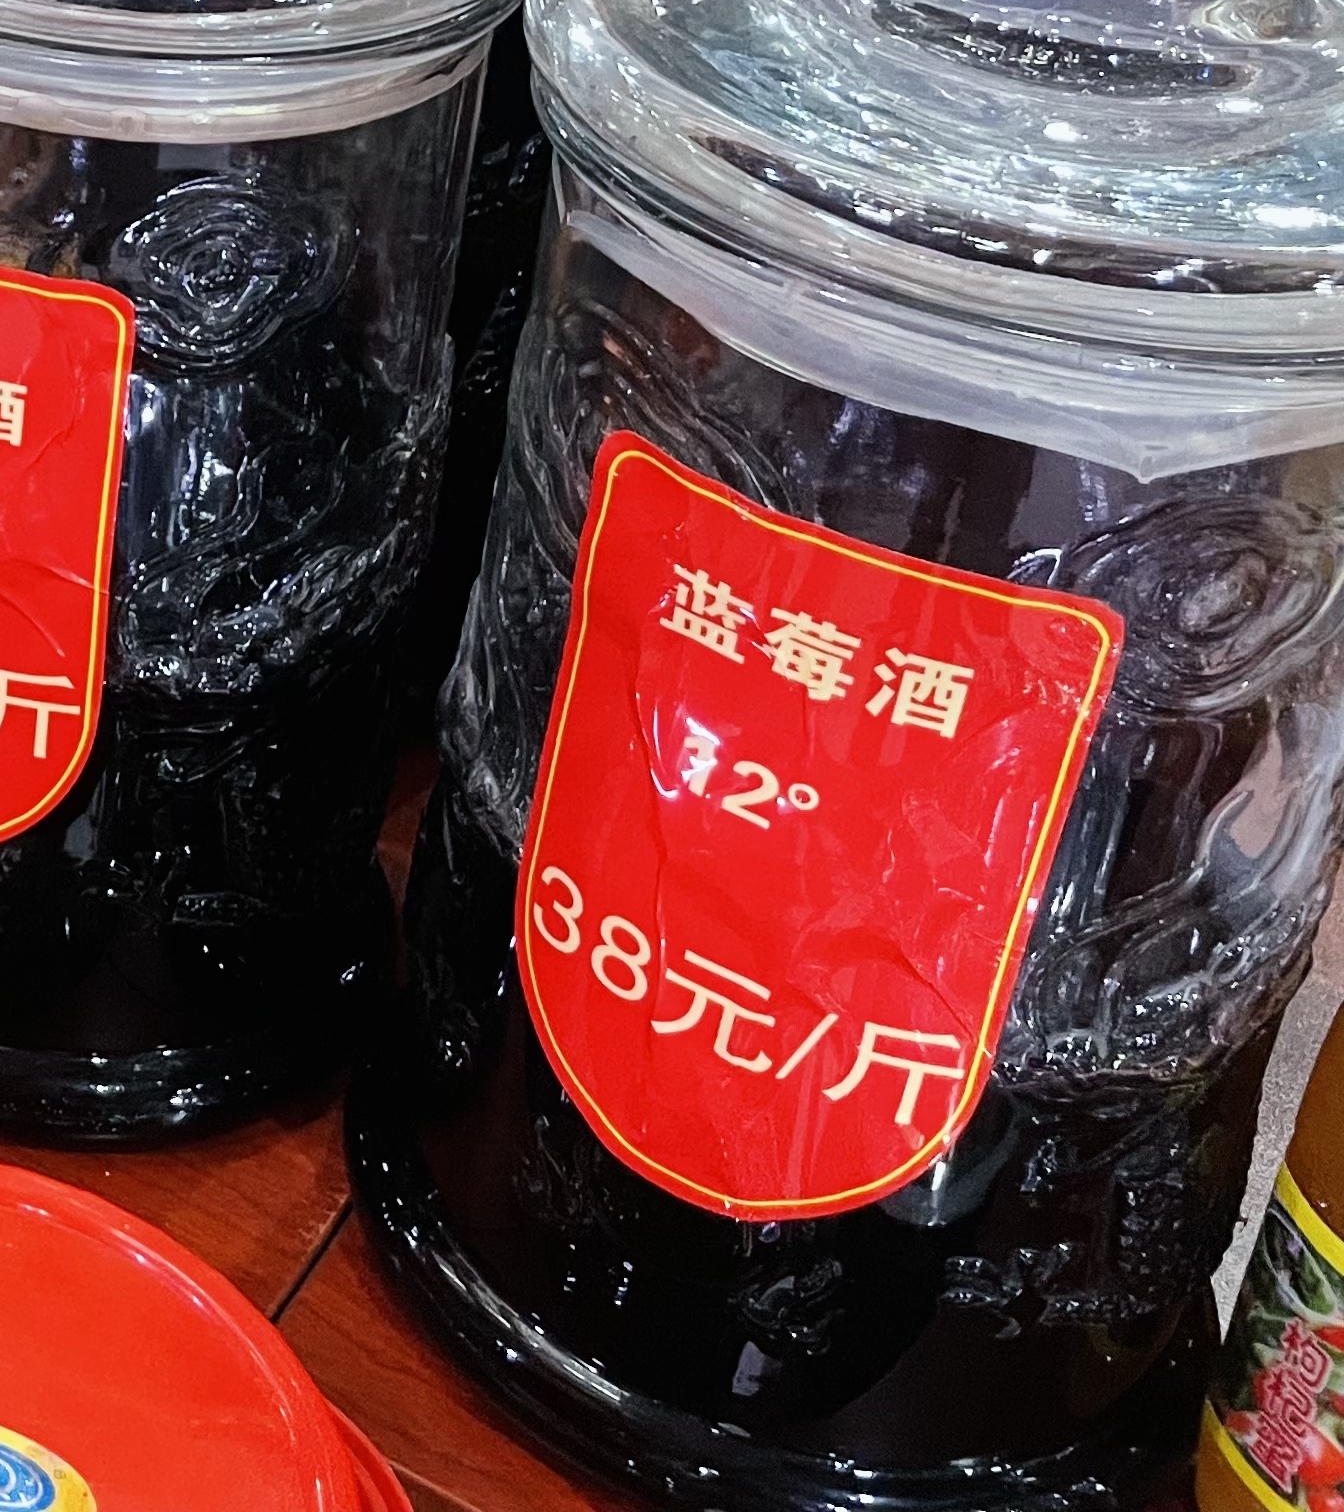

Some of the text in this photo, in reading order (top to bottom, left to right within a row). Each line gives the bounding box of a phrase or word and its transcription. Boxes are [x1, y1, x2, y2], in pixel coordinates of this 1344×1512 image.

[660, 563, 975, 740] 蓝莓酒
[680, 717, 820, 830] 12°
[532, 864, 966, 1126] 38元/斤
